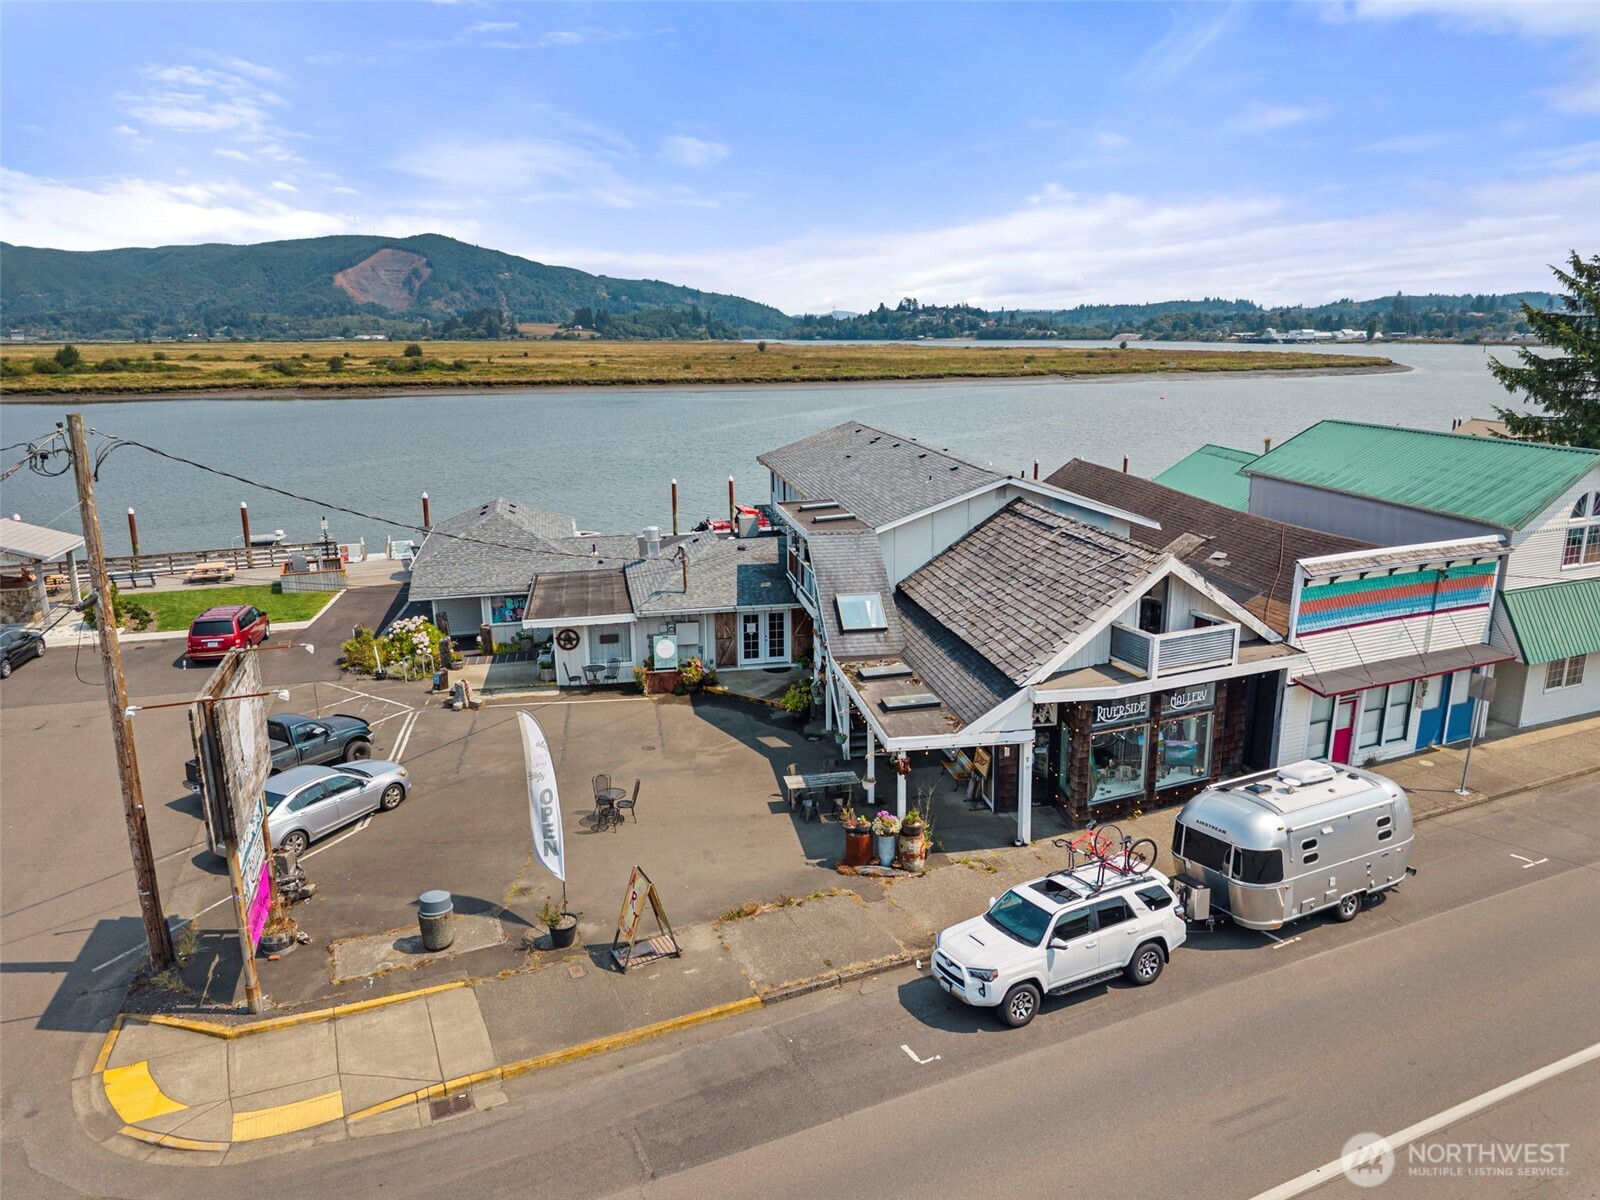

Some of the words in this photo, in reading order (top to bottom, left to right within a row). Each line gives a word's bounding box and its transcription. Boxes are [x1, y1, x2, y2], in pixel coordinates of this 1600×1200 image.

[1096, 701, 1147, 722] RIVERSIDE
[1170, 689, 1208, 710] GALLERY
[540, 788, 559, 857] OPEN
[1196, 819, 1227, 834] AIRSTREAM
